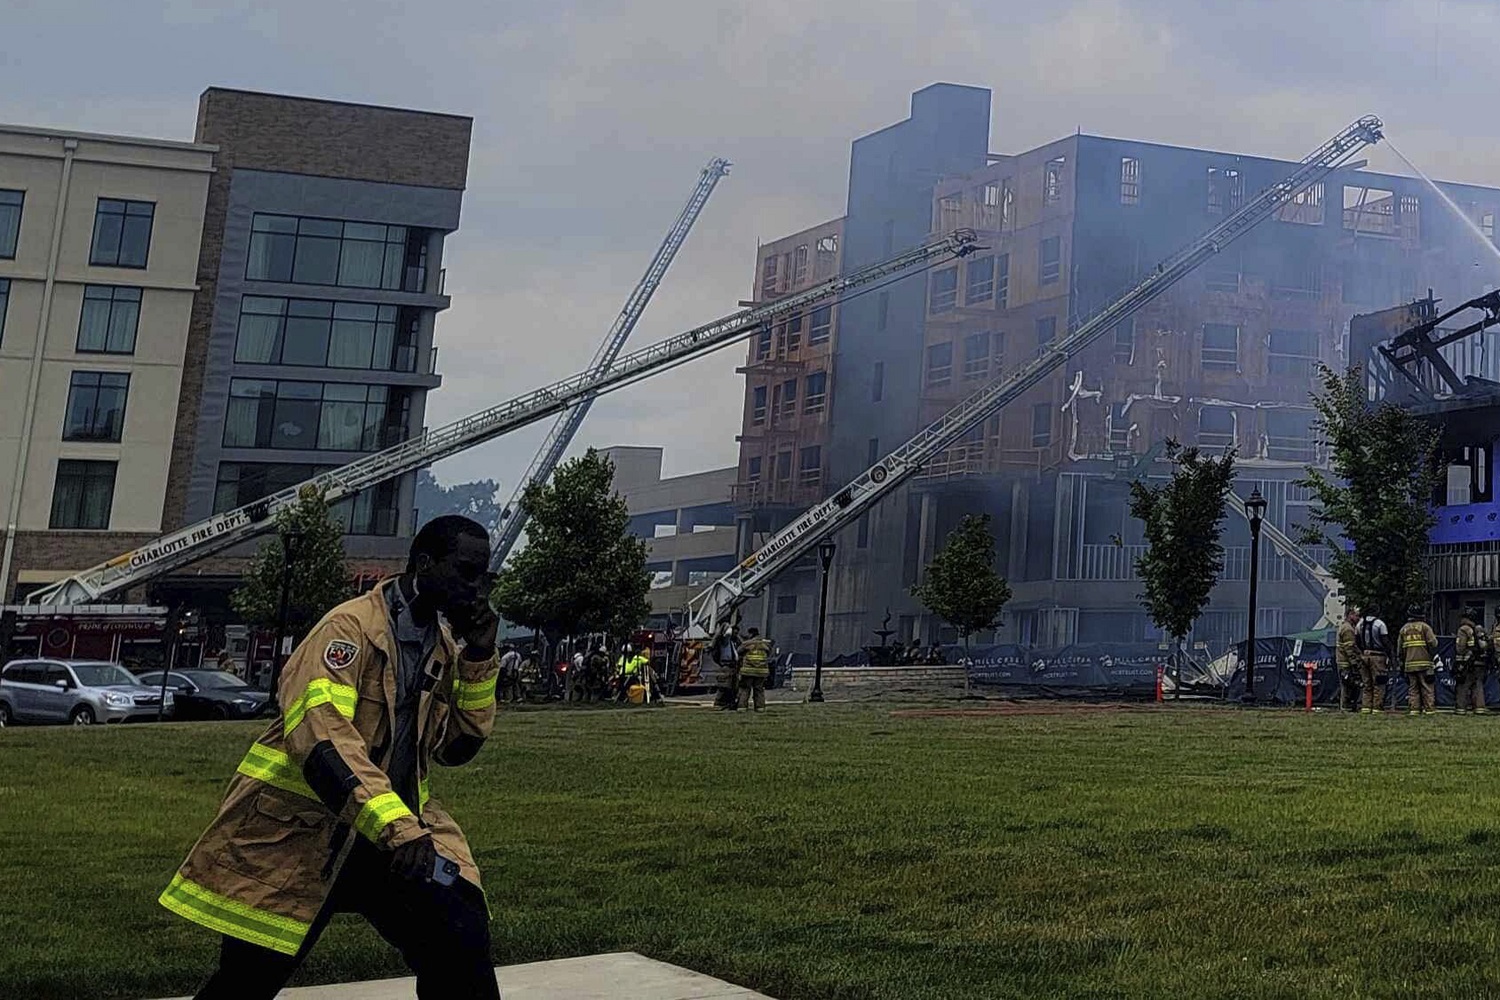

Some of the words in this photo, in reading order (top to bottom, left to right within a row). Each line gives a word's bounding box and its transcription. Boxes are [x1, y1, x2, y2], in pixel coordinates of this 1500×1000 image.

[131, 537, 189, 567] CHARLOTTE
[191, 526, 213, 543] FIRE
[216, 513, 245, 532] DEPT.
[757, 531, 796, 562] CHARLOTTE
[797, 518, 813, 533] FIRE
[814, 504, 834, 520] DEPT.
